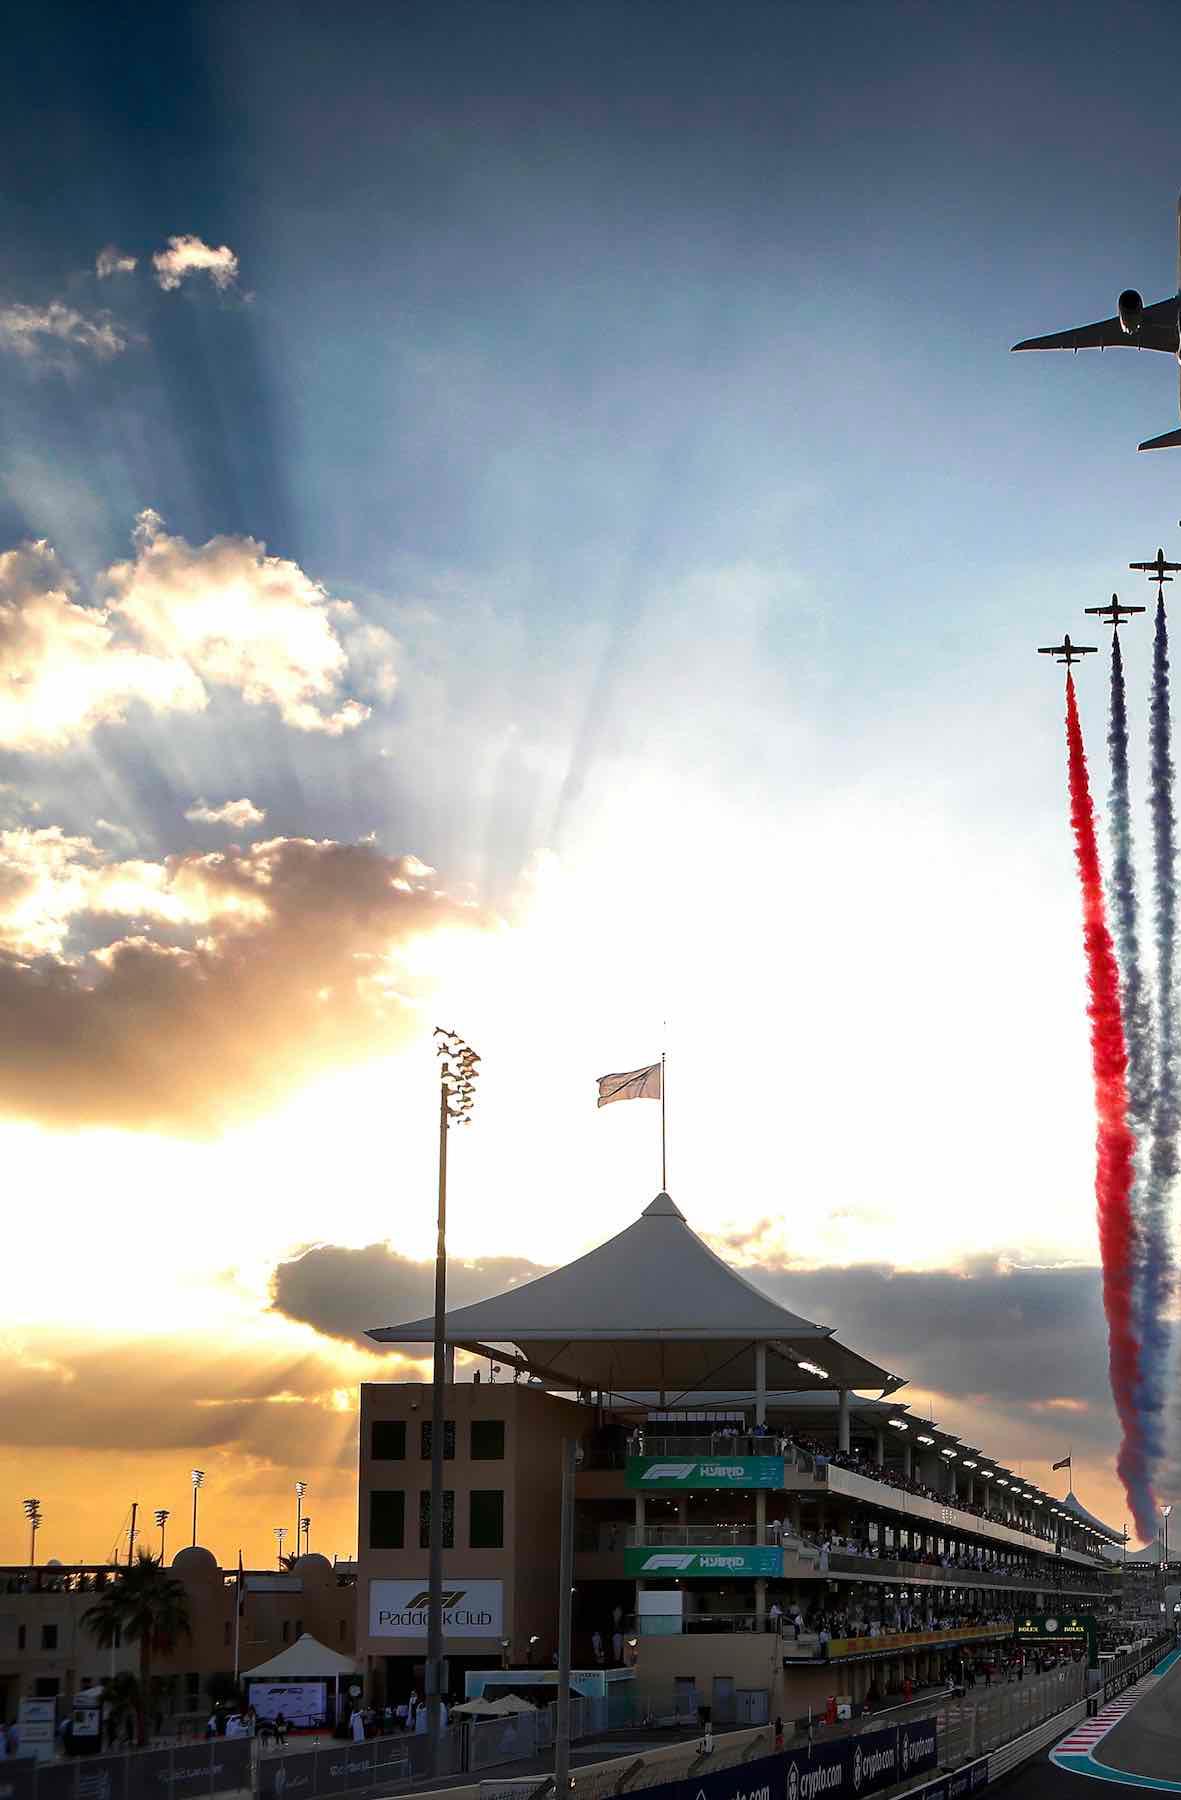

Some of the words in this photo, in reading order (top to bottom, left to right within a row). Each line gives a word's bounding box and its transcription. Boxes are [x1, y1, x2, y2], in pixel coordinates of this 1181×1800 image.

[699, 1465, 745, 1478] HYBRID
[699, 1556, 745, 1568] HYBRID
[379, 1610, 452, 1626] Paddk
[455, 1610, 492, 1625] Club
[909, 1736, 935, 1762] crypto.com
[862, 1748, 895, 1778] crypto.com
[799, 1763, 843, 1799] crypto.com
